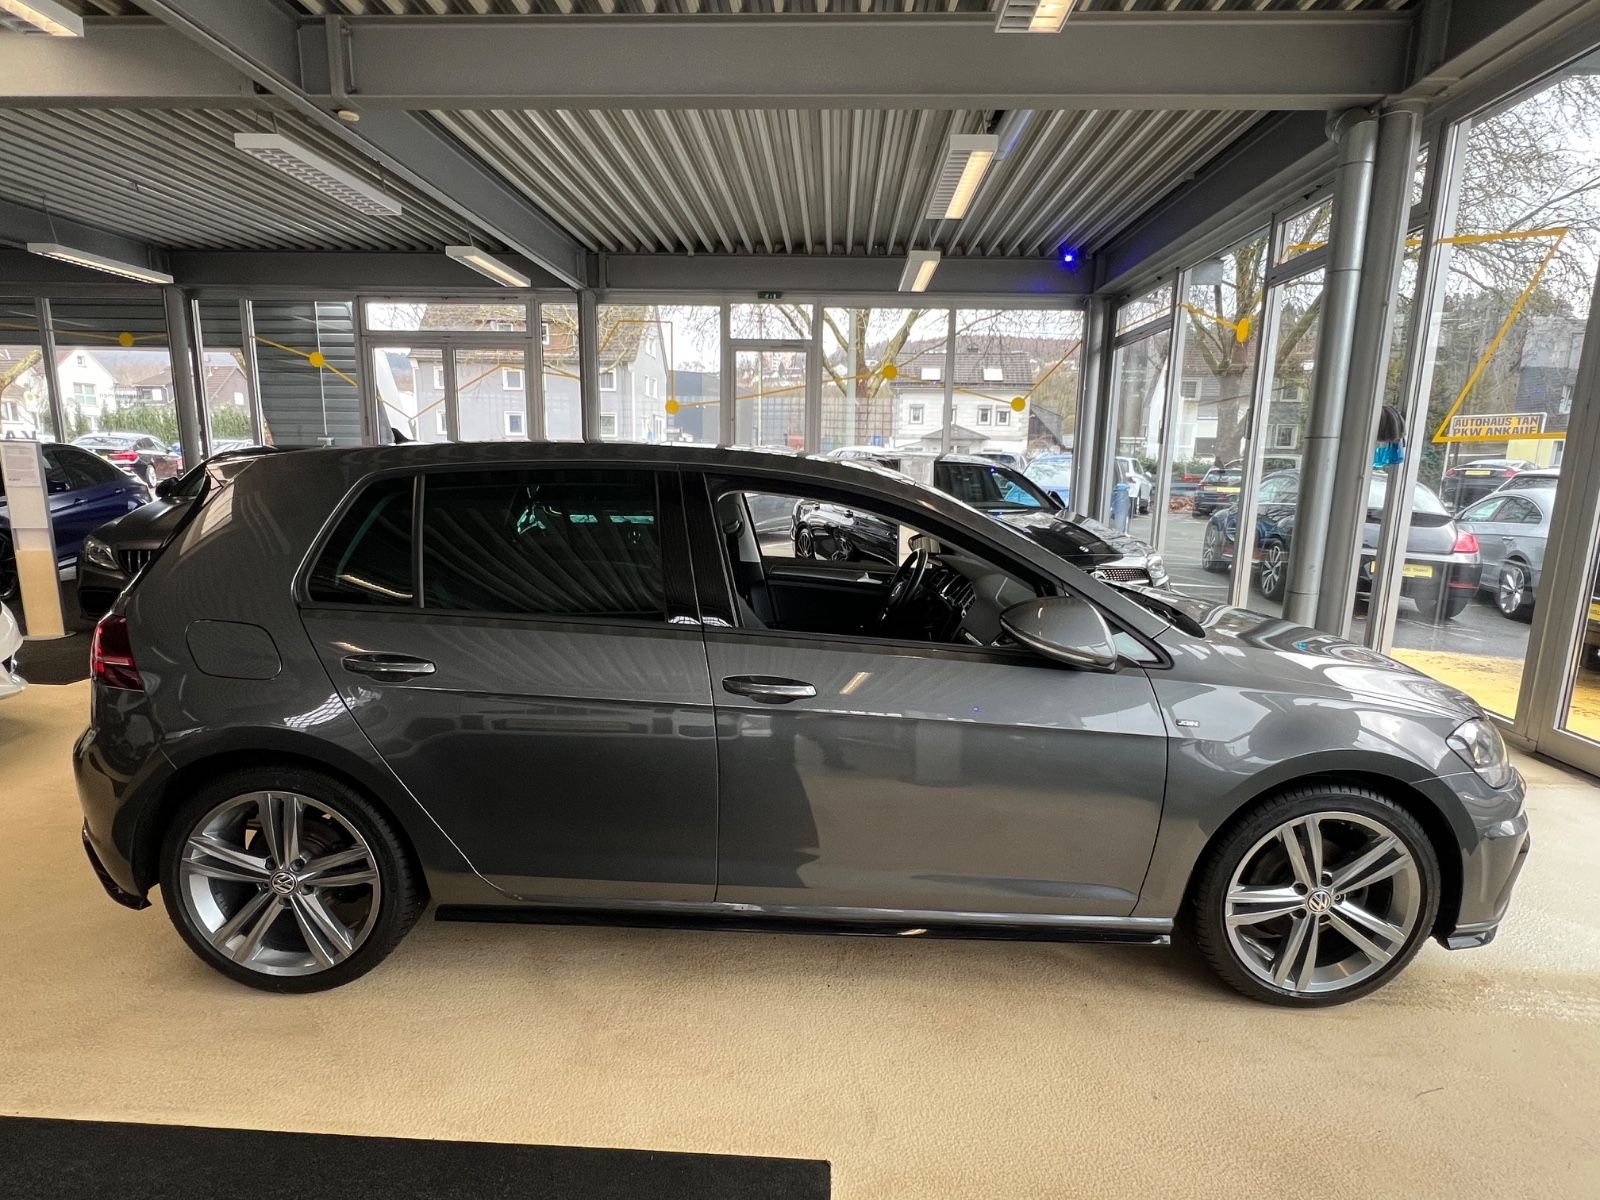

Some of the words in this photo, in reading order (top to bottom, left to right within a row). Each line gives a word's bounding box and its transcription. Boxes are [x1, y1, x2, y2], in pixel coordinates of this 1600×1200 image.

[1454, 417, 1512, 428] AUTOHAUS
[1517, 416, 1539, 425] TAN
[1453, 427, 1483, 437] PKW
